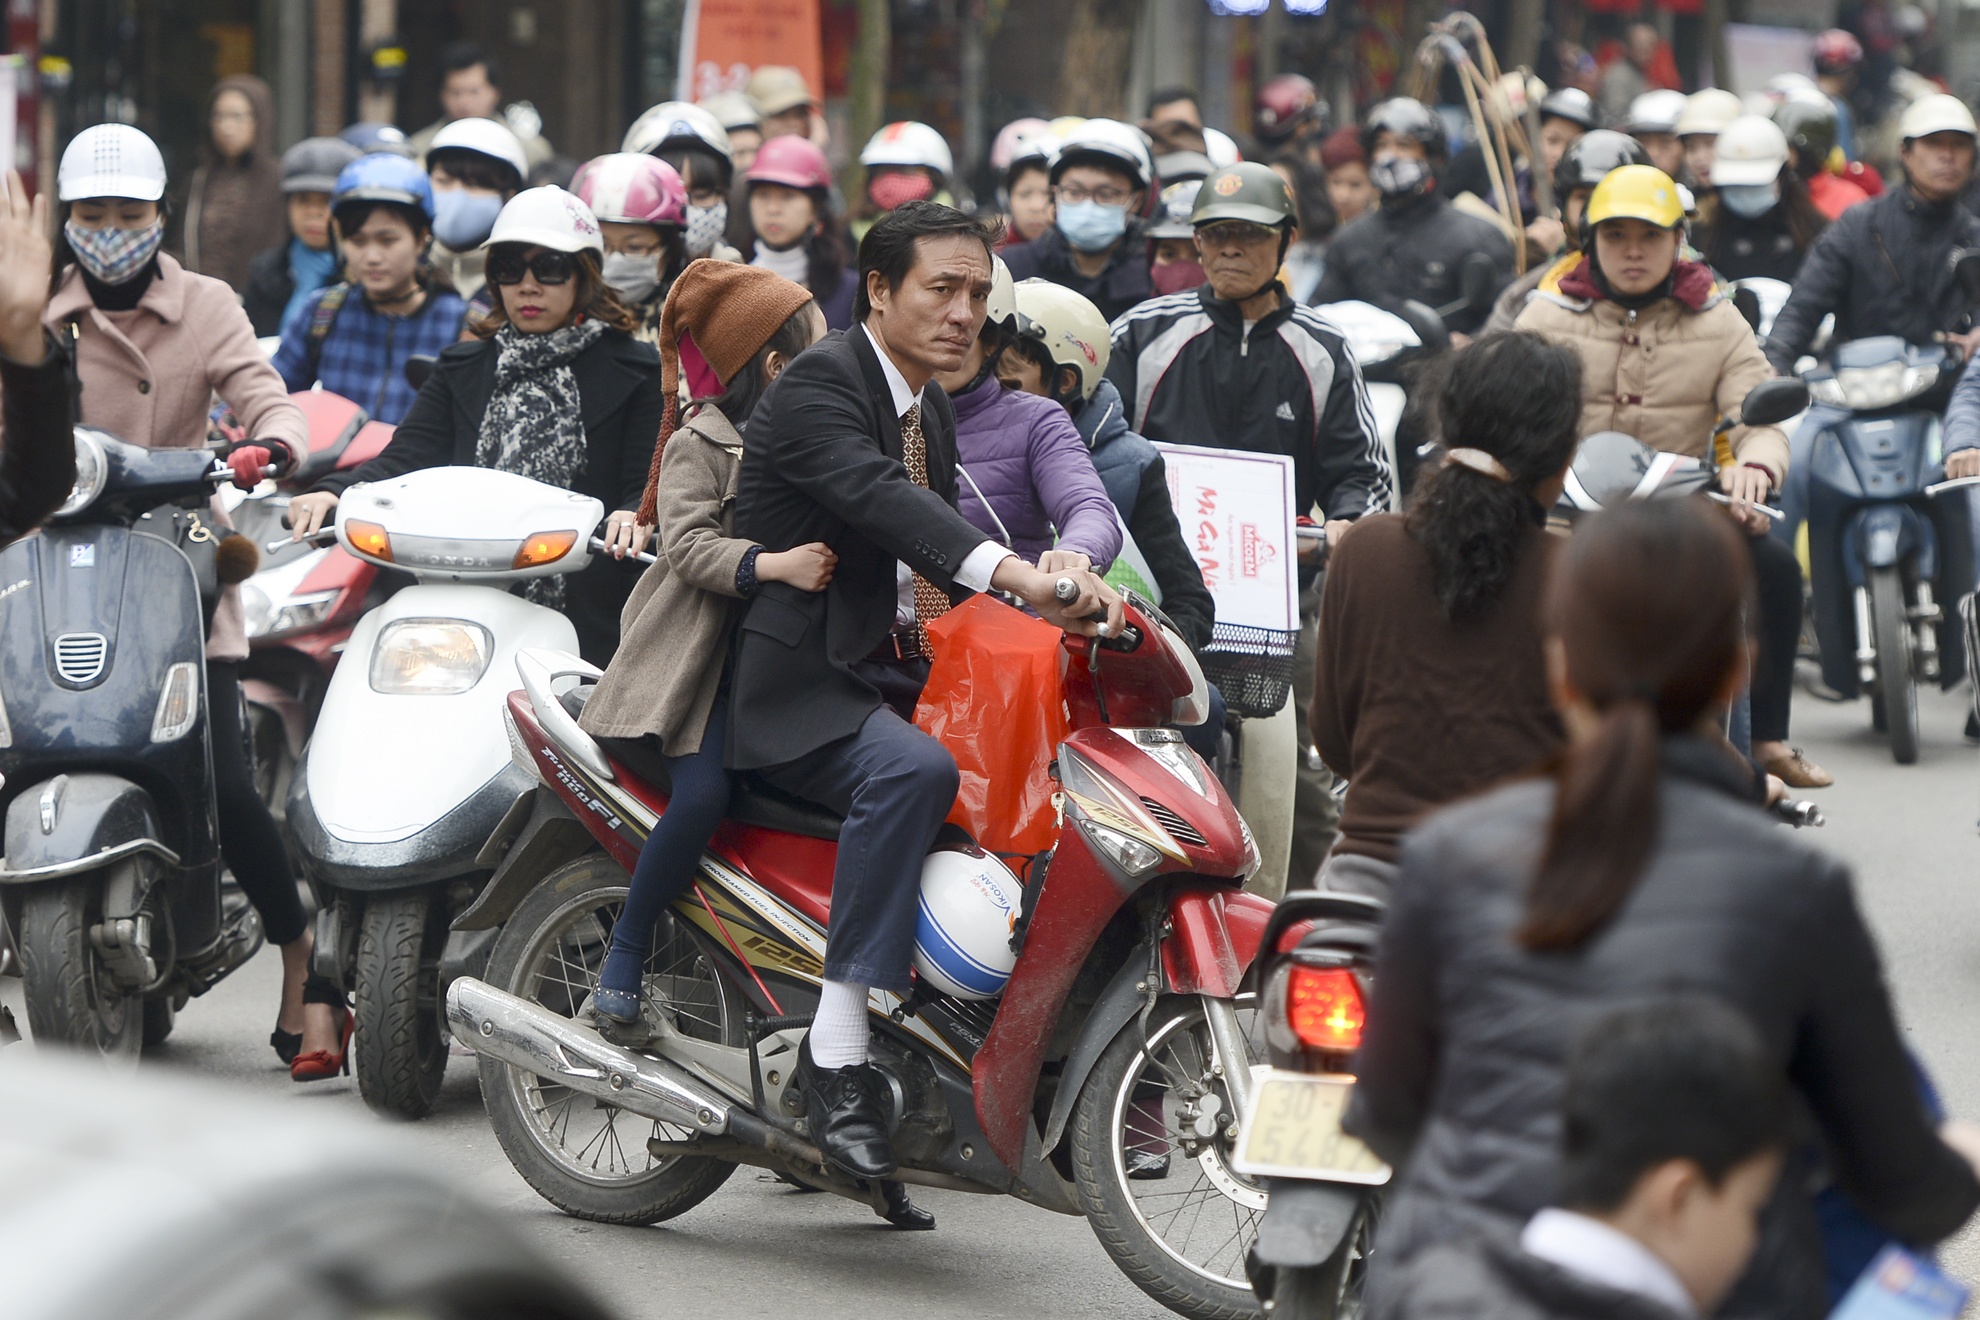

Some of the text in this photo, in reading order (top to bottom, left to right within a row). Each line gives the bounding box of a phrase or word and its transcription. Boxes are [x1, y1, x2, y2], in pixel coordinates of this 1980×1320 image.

[411, 553, 493, 567] HONDA
[704, 863, 811, 942] PROGRAMED FUEL INJECTION
